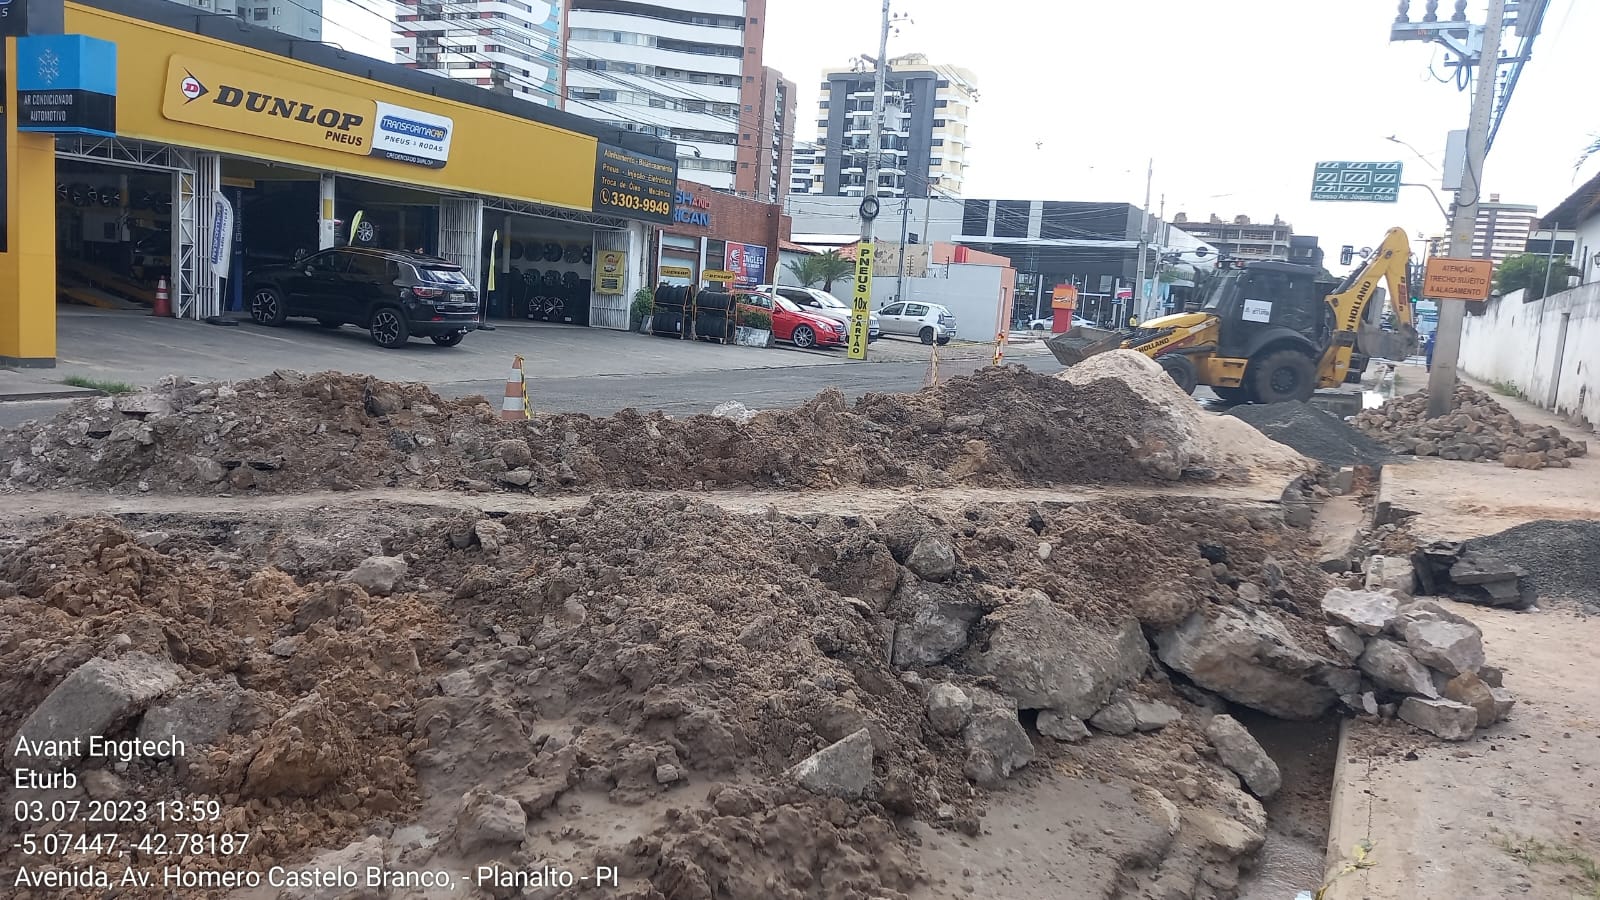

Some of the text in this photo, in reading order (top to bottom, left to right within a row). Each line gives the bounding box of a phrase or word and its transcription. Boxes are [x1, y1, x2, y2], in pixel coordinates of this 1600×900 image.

[24, 94, 73, 105] AR CONDICIONADO
[30, 110, 66, 121] AUTOMOTIVO
[212, 85, 363, 131] DUNLOP
[325, 131, 363, 147] PNEUS
[385, 135, 411, 146] PNEUS
[419, 142, 443, 152] RODAS
[602, 163, 619, 174] Pneus
[601, 176, 617, 187] Troca
[619, 181, 626, 189] de
[611, 192, 669, 215] 3303-9949
[857, 248, 870, 293] PNEUS
[1430, 275, 1486, 286] TRECHO SUJEITO
[1434, 286, 1481, 296] ALAGAMENTO
[1350, 281, 1371, 323] HOLLAND
[1138, 337, 1169, 353] HOLLAND
